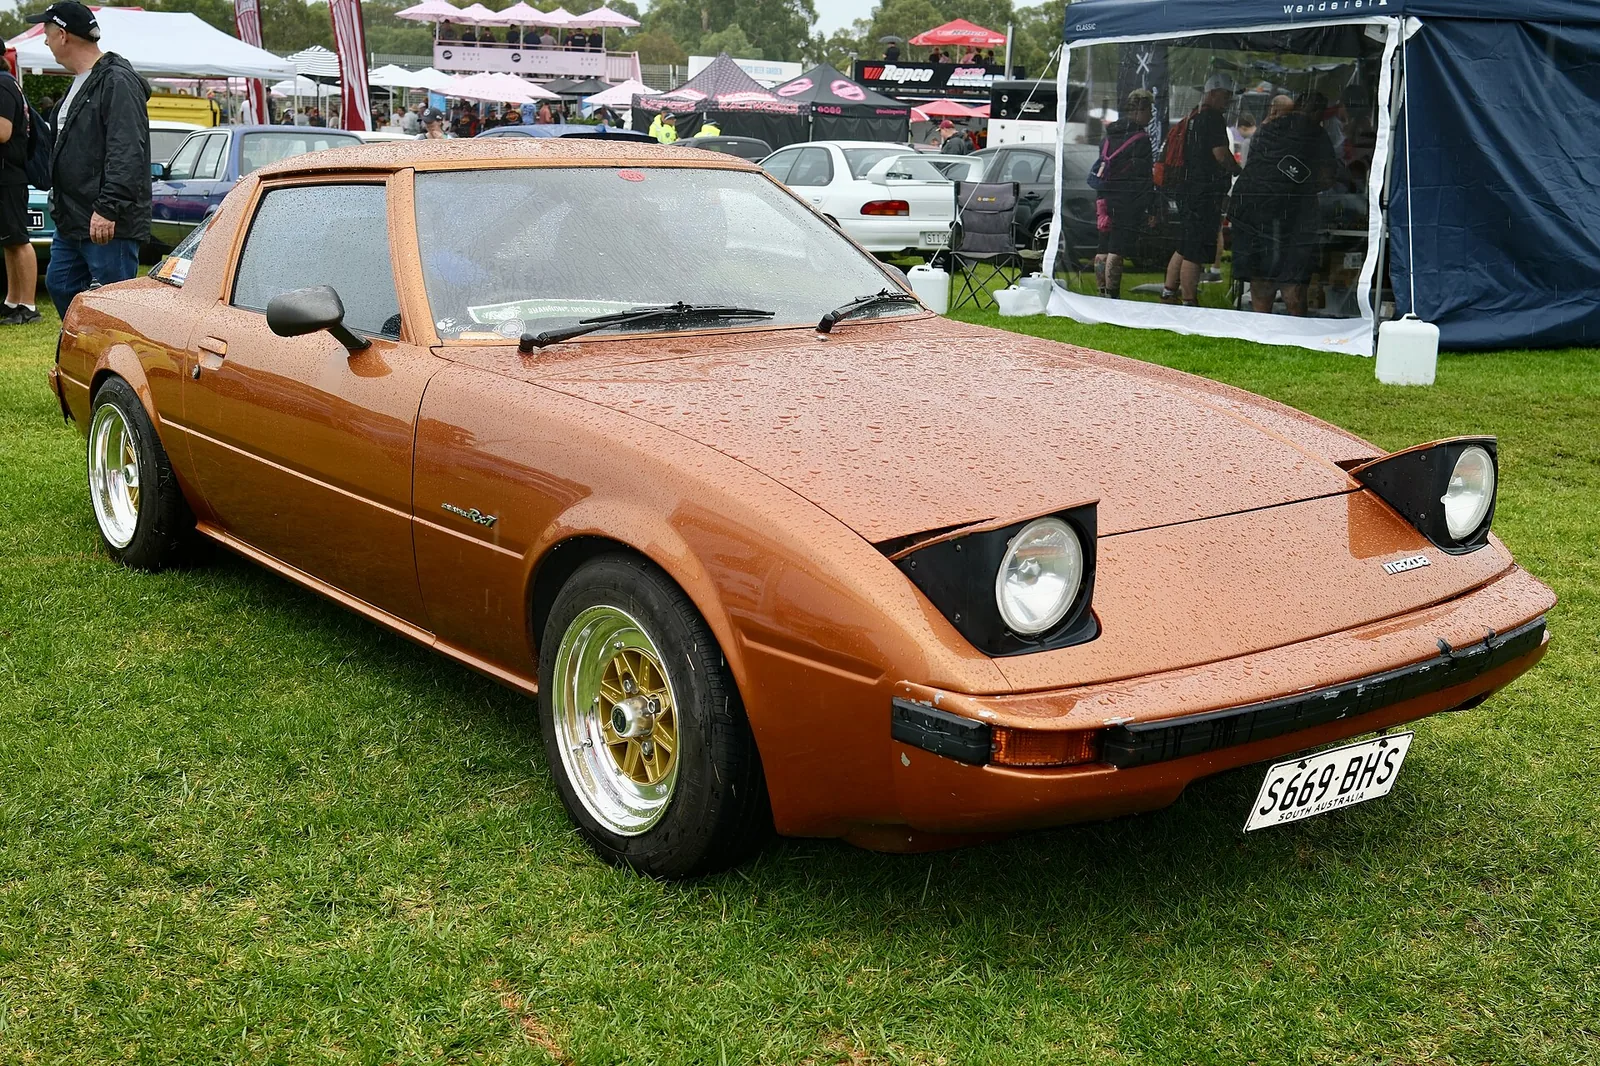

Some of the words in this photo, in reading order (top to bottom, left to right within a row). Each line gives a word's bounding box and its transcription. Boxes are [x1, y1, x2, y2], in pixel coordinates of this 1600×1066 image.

[1283, 0, 1373, 14] Wanderer
[1076, 23, 1096, 32] CLASSIC
[879, 64, 934, 84] Repco
[1278, 806, 1312, 822] SOUTH
[1314, 792, 1364, 812] AUSTRALIA
